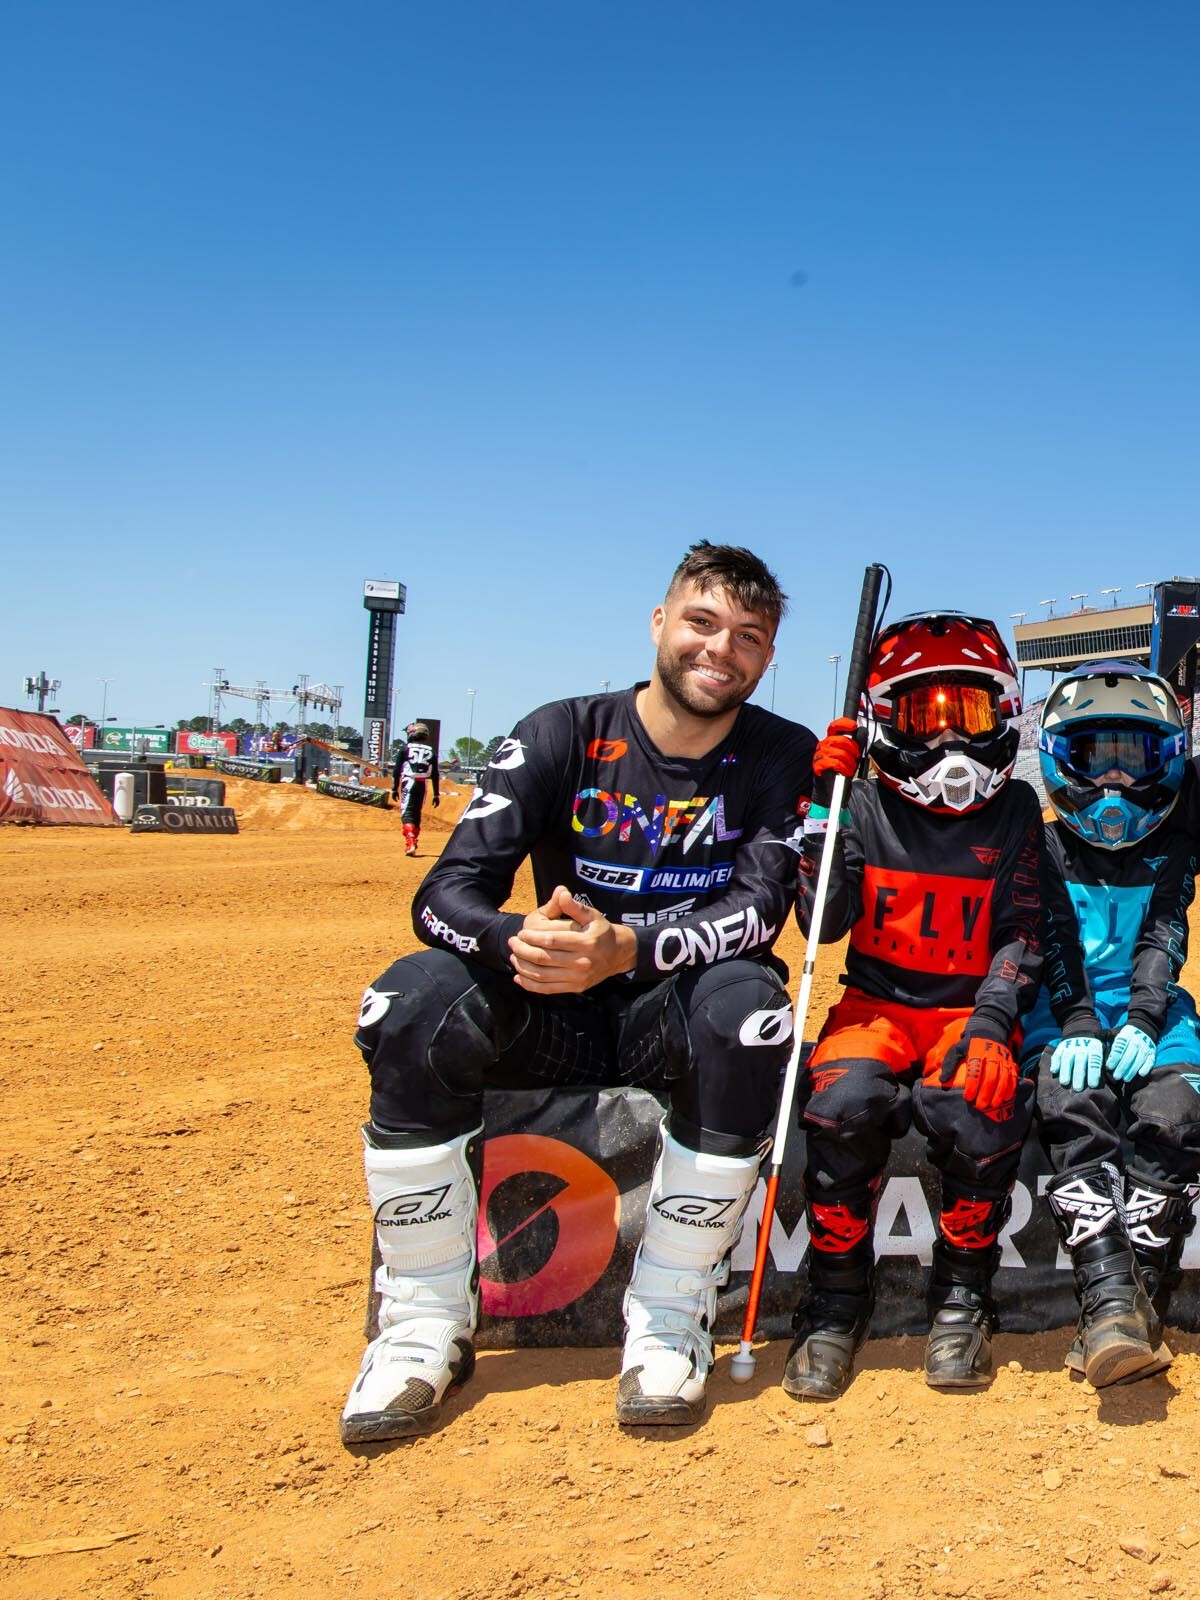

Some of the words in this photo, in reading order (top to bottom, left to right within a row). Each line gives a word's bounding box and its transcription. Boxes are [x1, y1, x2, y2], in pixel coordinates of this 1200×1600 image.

[408, 747, 433, 766] 512
[23, 782, 102, 811] HONDA
[580, 863, 637, 887] SGB
[873, 885, 985, 942] FLY
[873, 935, 973, 961] RACING
[1065, 1039, 1091, 1048] FLY
